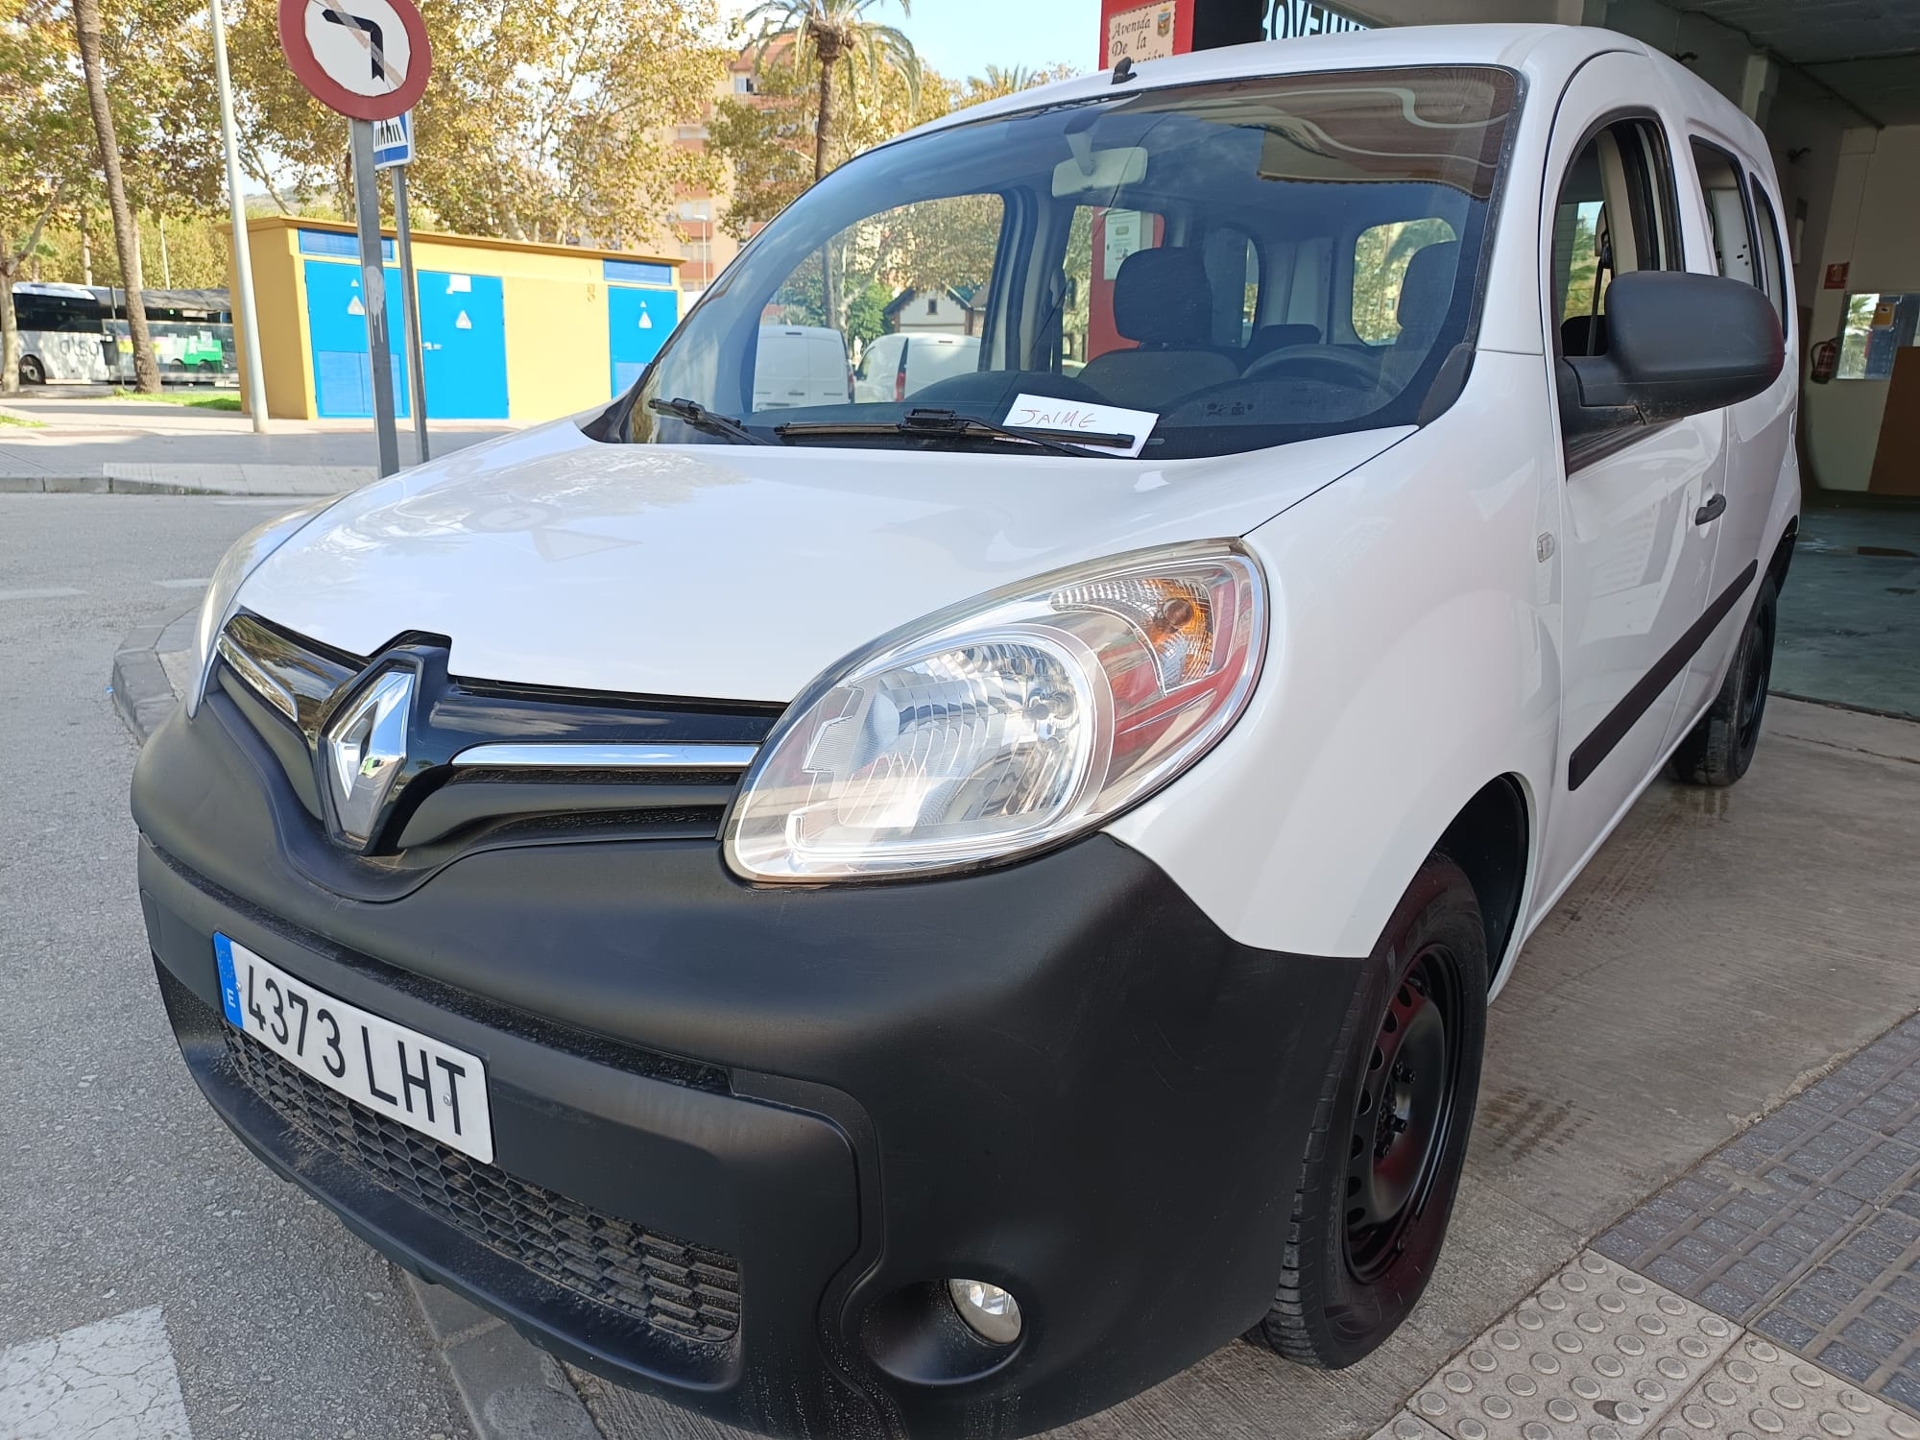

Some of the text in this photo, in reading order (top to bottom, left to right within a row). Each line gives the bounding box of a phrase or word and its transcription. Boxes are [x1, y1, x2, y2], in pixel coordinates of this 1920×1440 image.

[1111, 12, 1151, 40] Avenida
[1111, 30, 1147, 57] De la
[1014, 408, 1096, 428] JAIME
[226, 990, 236, 1008] E
[248, 965, 466, 1136] 4373 LHT
